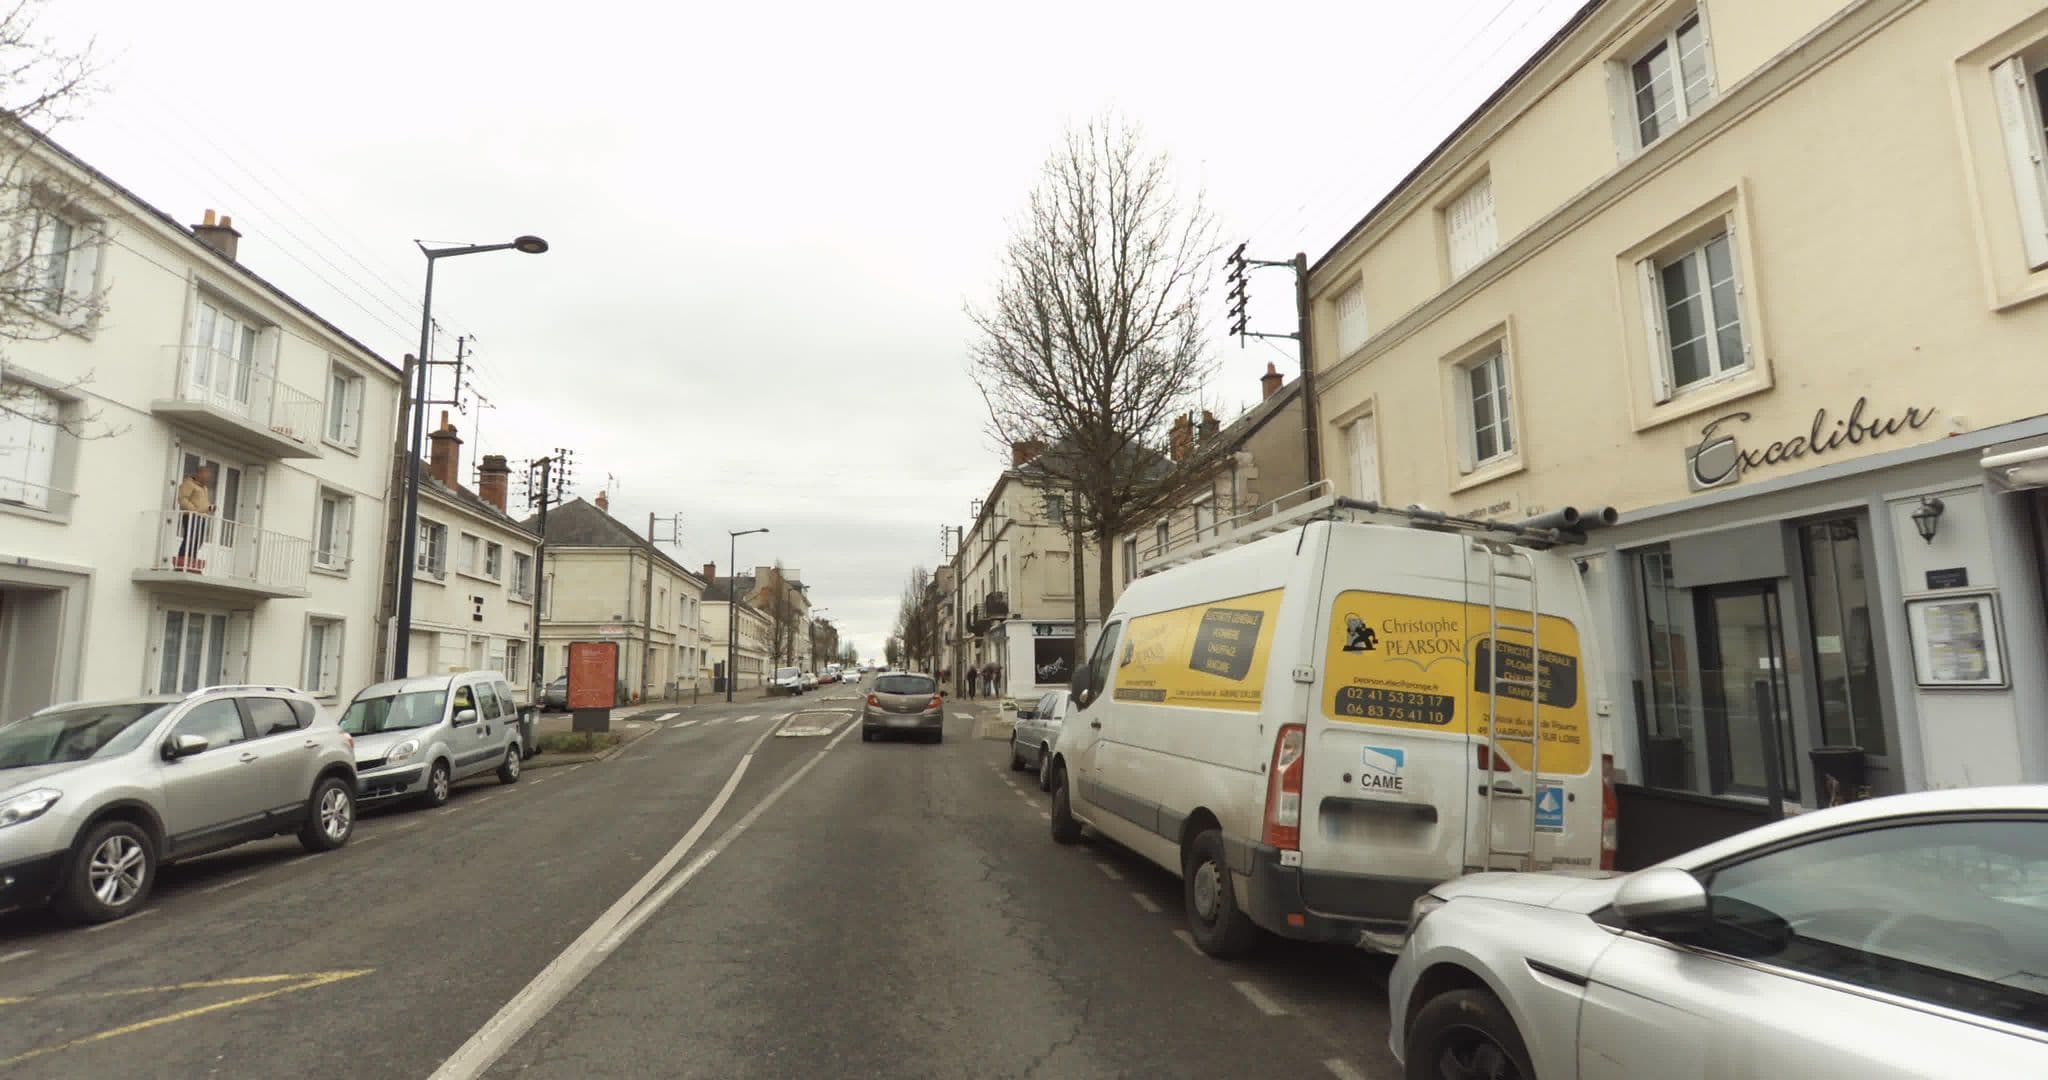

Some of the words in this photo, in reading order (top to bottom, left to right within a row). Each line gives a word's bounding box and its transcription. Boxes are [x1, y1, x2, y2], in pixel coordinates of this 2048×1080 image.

[1693, 396, 1936, 485] Excalibur
[1382, 616, 1458, 637] Christophe
[1386, 638, 1461, 656] PEARSON
[1346, 687, 1364, 700] 02
[1367, 691, 1383, 700] 41
[1388, 692, 1404, 704] 53
[1407, 694, 1425, 706] 23
[1429, 696, 1444, 707] 17
[1346, 703, 1364, 714] 06
[1367, 705, 1384, 717] 83
[1388, 707, 1404, 719] 75
[1408, 709, 1423, 720] 41
[1429, 711, 1444, 723] 10
[1361, 773, 1404, 790] CAME
